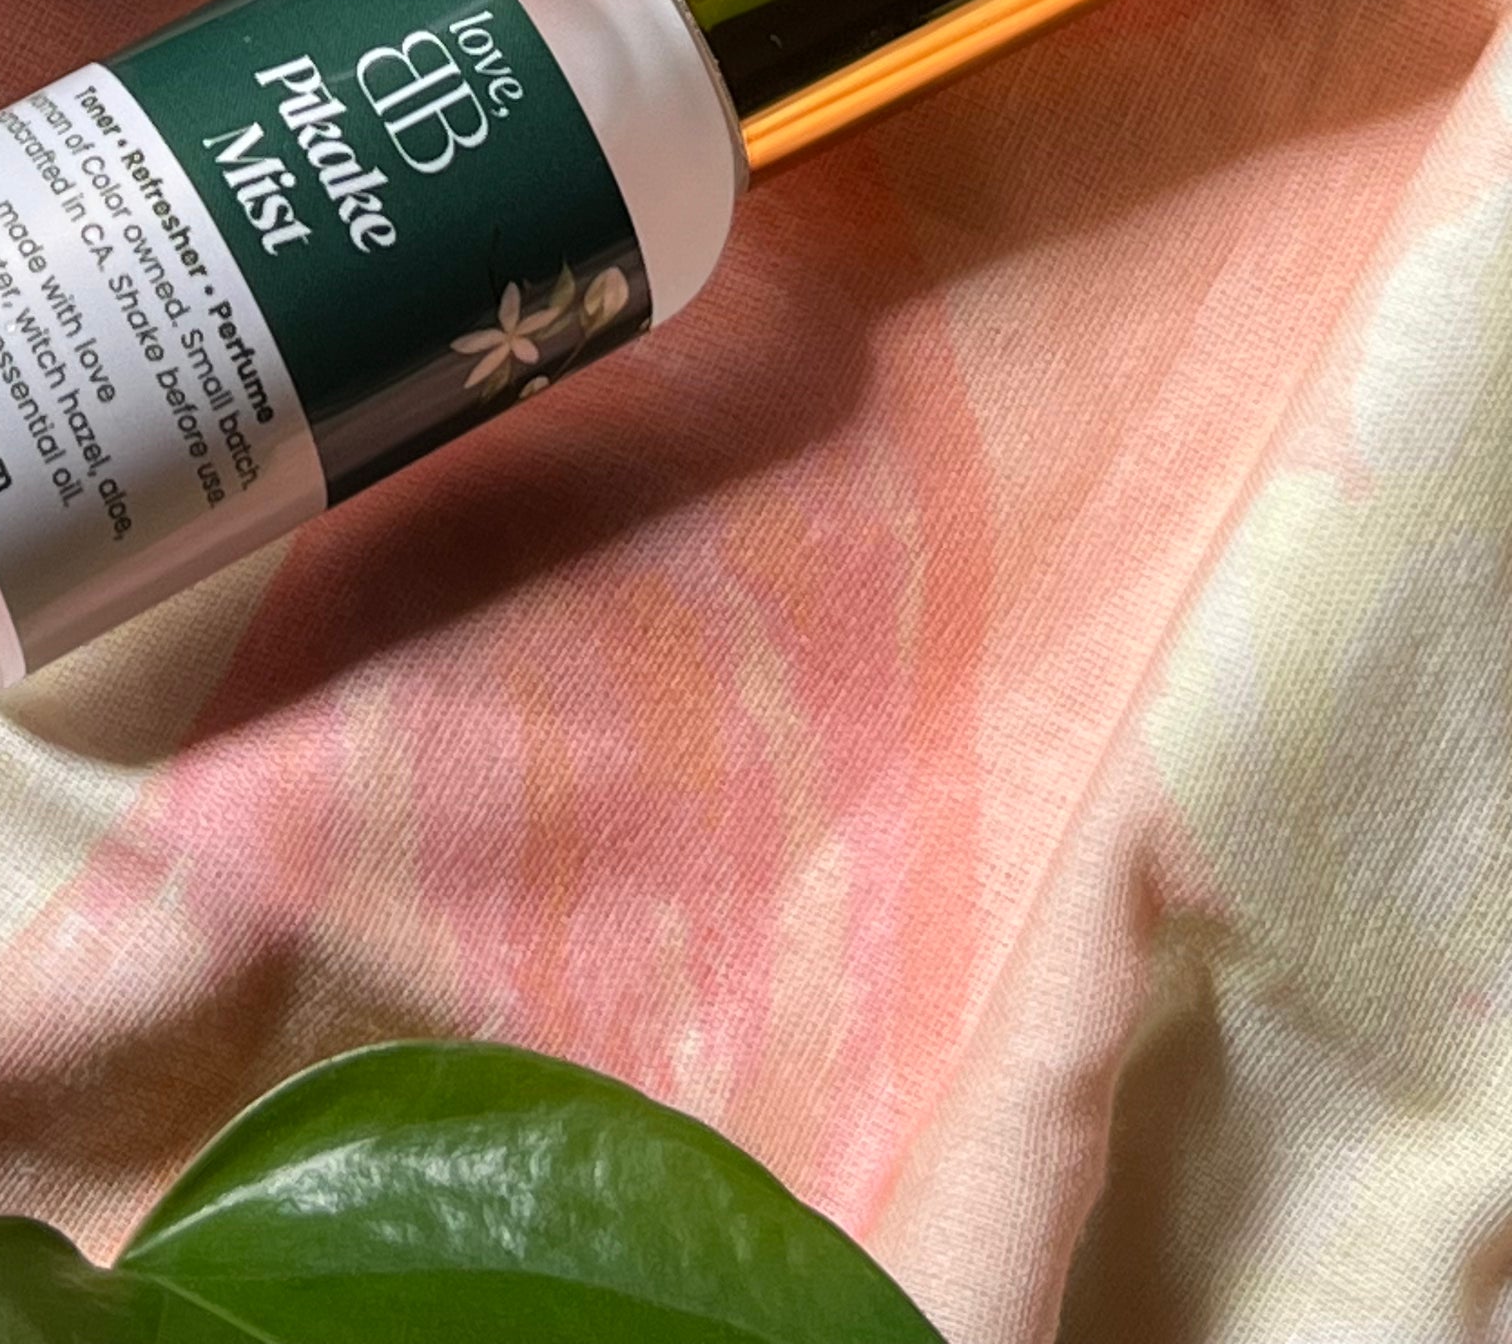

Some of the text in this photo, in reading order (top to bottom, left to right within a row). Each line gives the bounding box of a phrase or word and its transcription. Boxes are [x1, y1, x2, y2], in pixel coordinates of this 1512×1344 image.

[449, 10, 524, 118] love,
[64, 134, 95, 155] of
[80, 155, 133, 219] Color
[123, 224, 191, 328] owned.
[181, 328, 234, 412] Small
[74, 85, 275, 425] Toner Refresher Perfume
[202, 122, 313, 256] Mist
[15, 307, 66, 390] witch
[58, 388, 111, 478] hazel,
[98, 478, 133, 541] aloe,
[40, 274, 83, 338] with
[74, 337, 116, 403] love
[61, 192, 87, 223] in
[80, 223, 113, 272] CA.
[108, 273, 165, 362] Shake
[156, 367, 208, 458] before
[197, 463, 226, 509] use.
[52, 467, 84, 508] oil.
